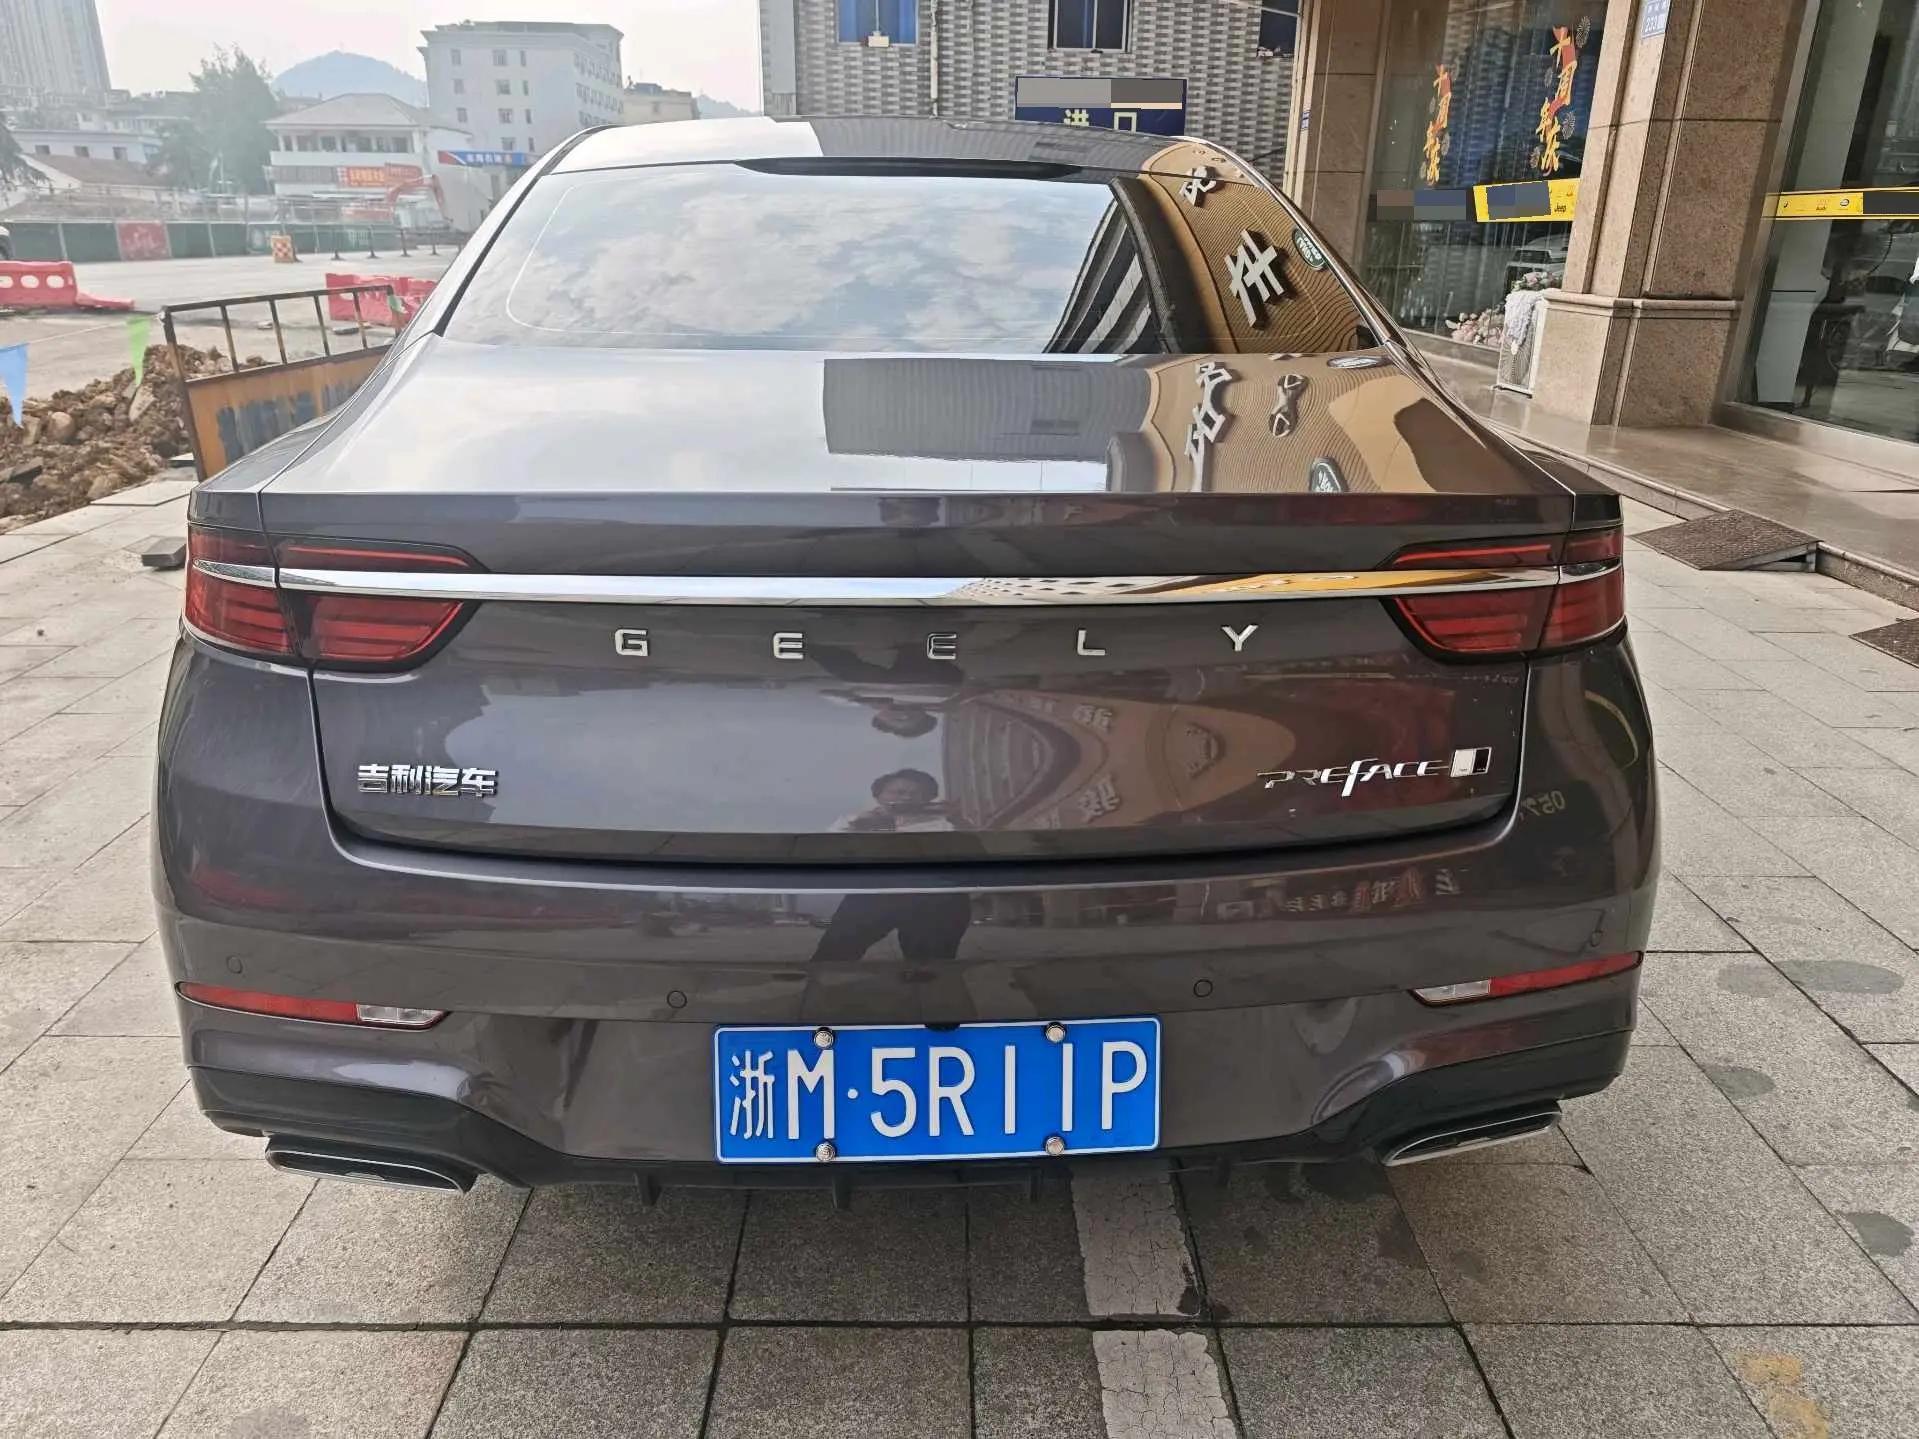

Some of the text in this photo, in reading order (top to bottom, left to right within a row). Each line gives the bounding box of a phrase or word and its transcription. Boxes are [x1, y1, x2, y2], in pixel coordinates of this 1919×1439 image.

[614, 624, 1259, 660] GEELY
[357, 763, 496, 797] 吉利汽车
[1257, 757, 1450, 798] PREFACE
